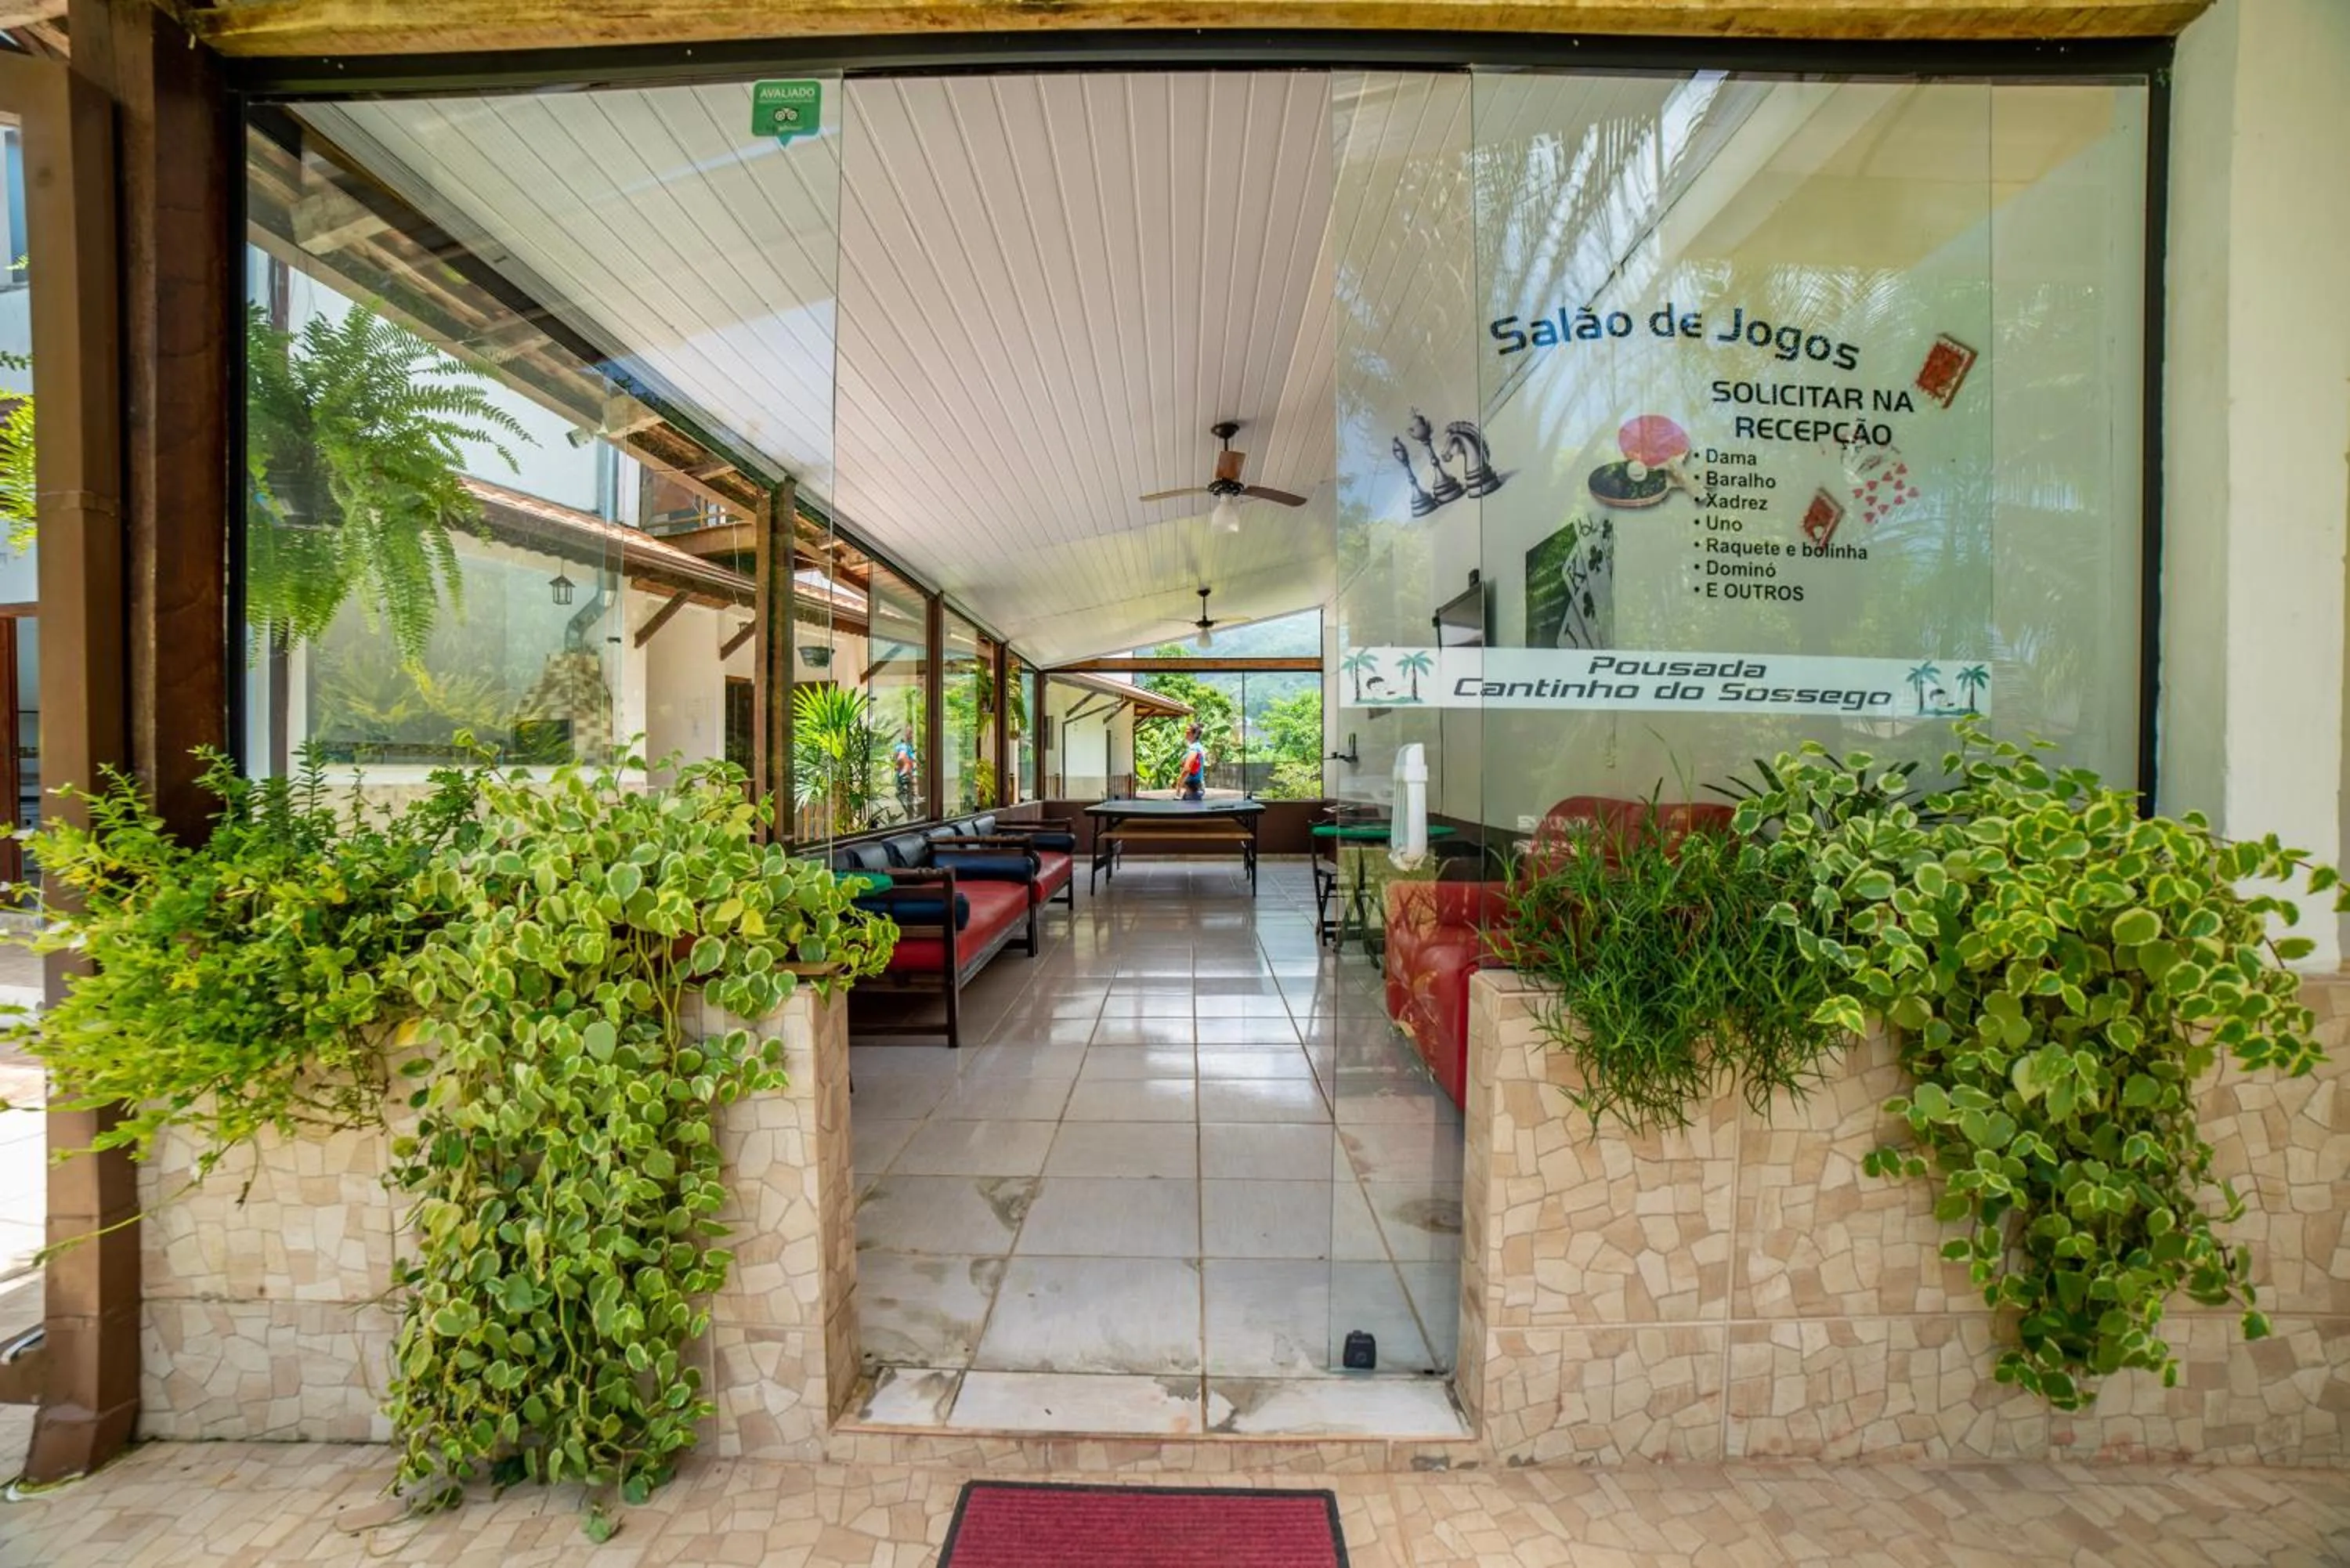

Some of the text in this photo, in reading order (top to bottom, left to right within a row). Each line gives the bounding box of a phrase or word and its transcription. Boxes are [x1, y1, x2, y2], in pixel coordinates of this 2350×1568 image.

[759, 87, 815, 99] AVALIADO
[1490, 302, 1860, 371] Salão de Jogos
[1712, 381, 1914, 413] SOLICITAR NA
[1735, 416, 1893, 446] RECEPÇÃO
[1706, 449, 1757, 466] Dama
[1706, 471, 1777, 489] Baralho
[1706, 493, 1768, 511] Xadrez
[1706, 515, 1743, 532] Uno
[1706, 537, 1867, 560] Raquete e bolinha
[1706, 559, 1777, 578] Dominó
[1706, 582, 1804, 602] E OUTROS
[1589, 656, 1766, 678] Pousada
[1453, 677, 1893, 710] Cantinho do Sossego
